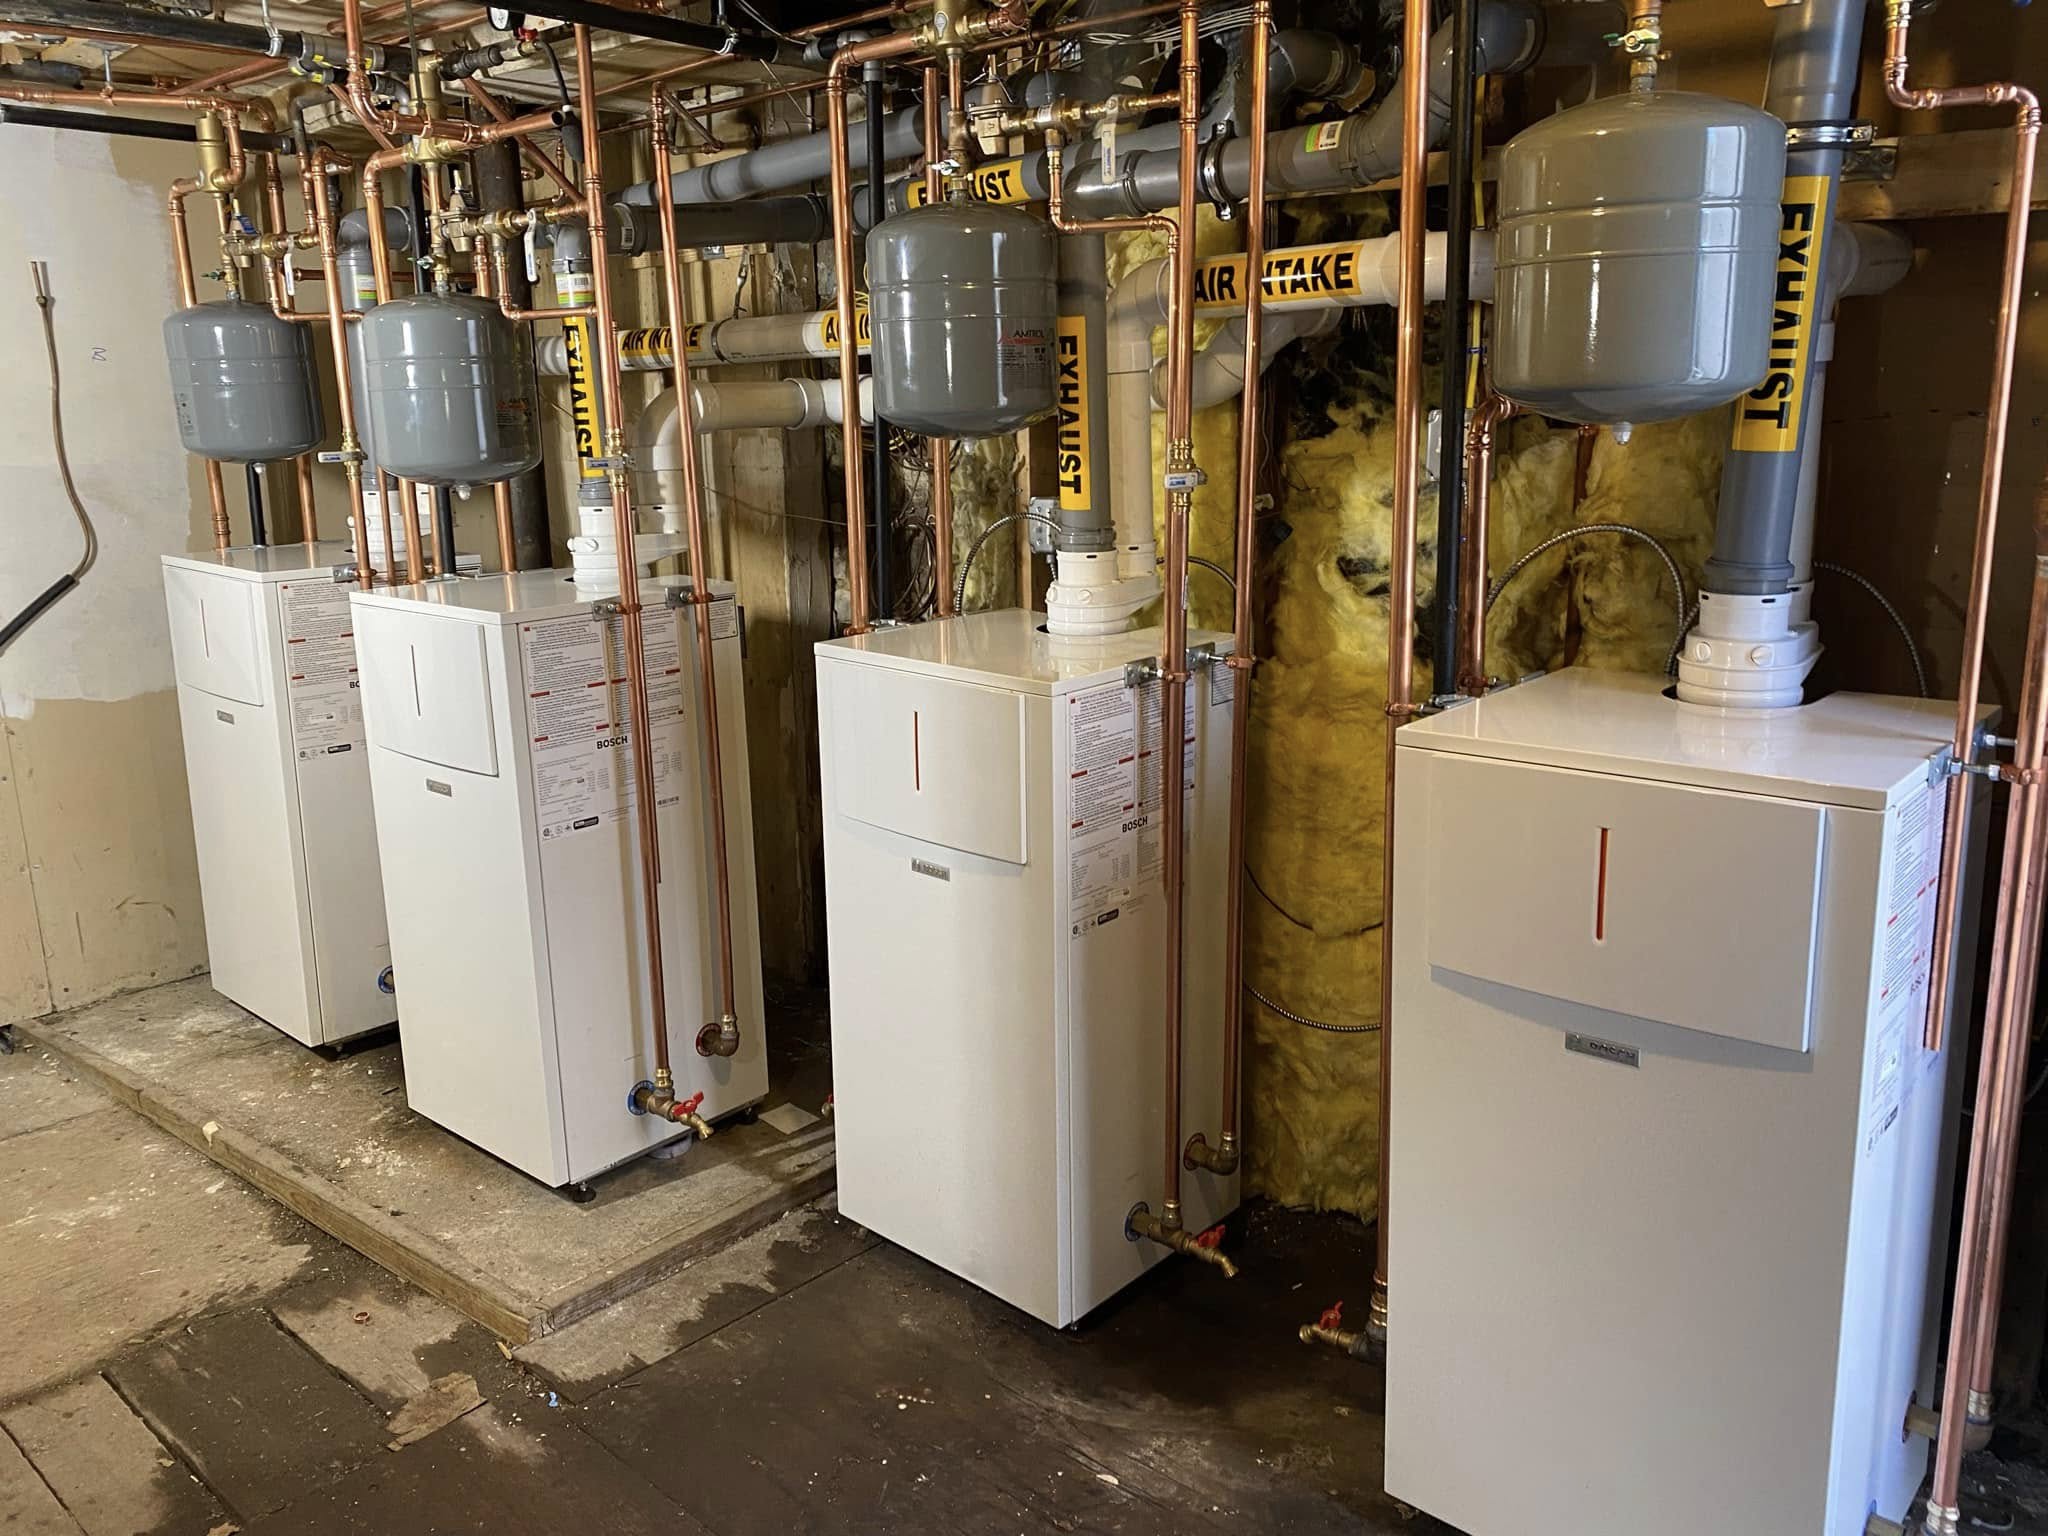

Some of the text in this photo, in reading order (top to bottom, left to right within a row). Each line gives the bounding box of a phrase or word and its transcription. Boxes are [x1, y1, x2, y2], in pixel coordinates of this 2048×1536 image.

[918, 169, 1012, 206] EUST
[1193, 252, 1355, 303] AIR NTAKE
[1744, 203, 1816, 429] EXHAUST
[622, 327, 649, 351] AIR
[562, 325, 593, 458] EXHAUST
[1058, 335, 1082, 495] EXHAUST
[596, 735, 628, 749] BOSCH
[1122, 816, 1148, 832] BOSCH
